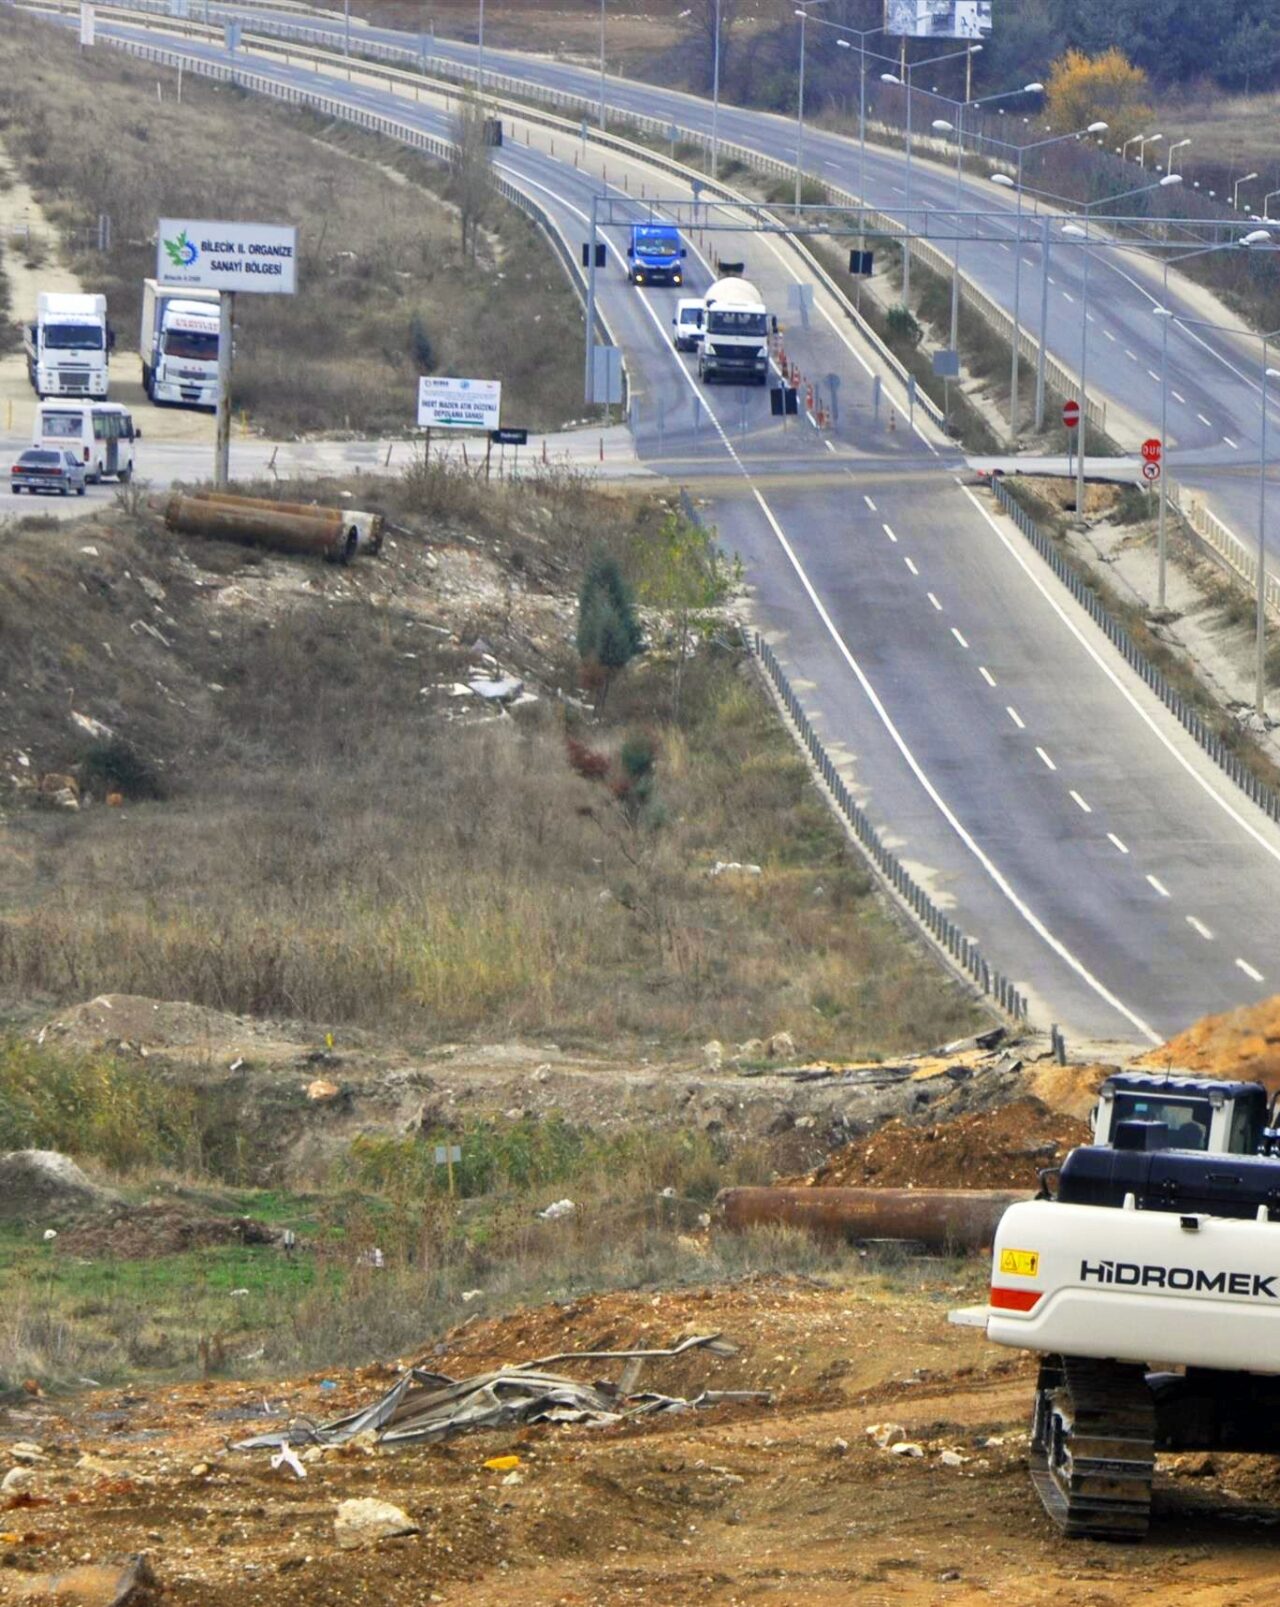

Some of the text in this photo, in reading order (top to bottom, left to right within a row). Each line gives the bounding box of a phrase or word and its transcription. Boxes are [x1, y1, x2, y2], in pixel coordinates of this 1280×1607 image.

[201, 240, 234, 253] BİLECİK
[248, 244, 293, 257] ORGANİZE
[210, 259, 282, 275] SANAYİ BÖLGESİ
[1143, 445, 1161, 456] DUR
